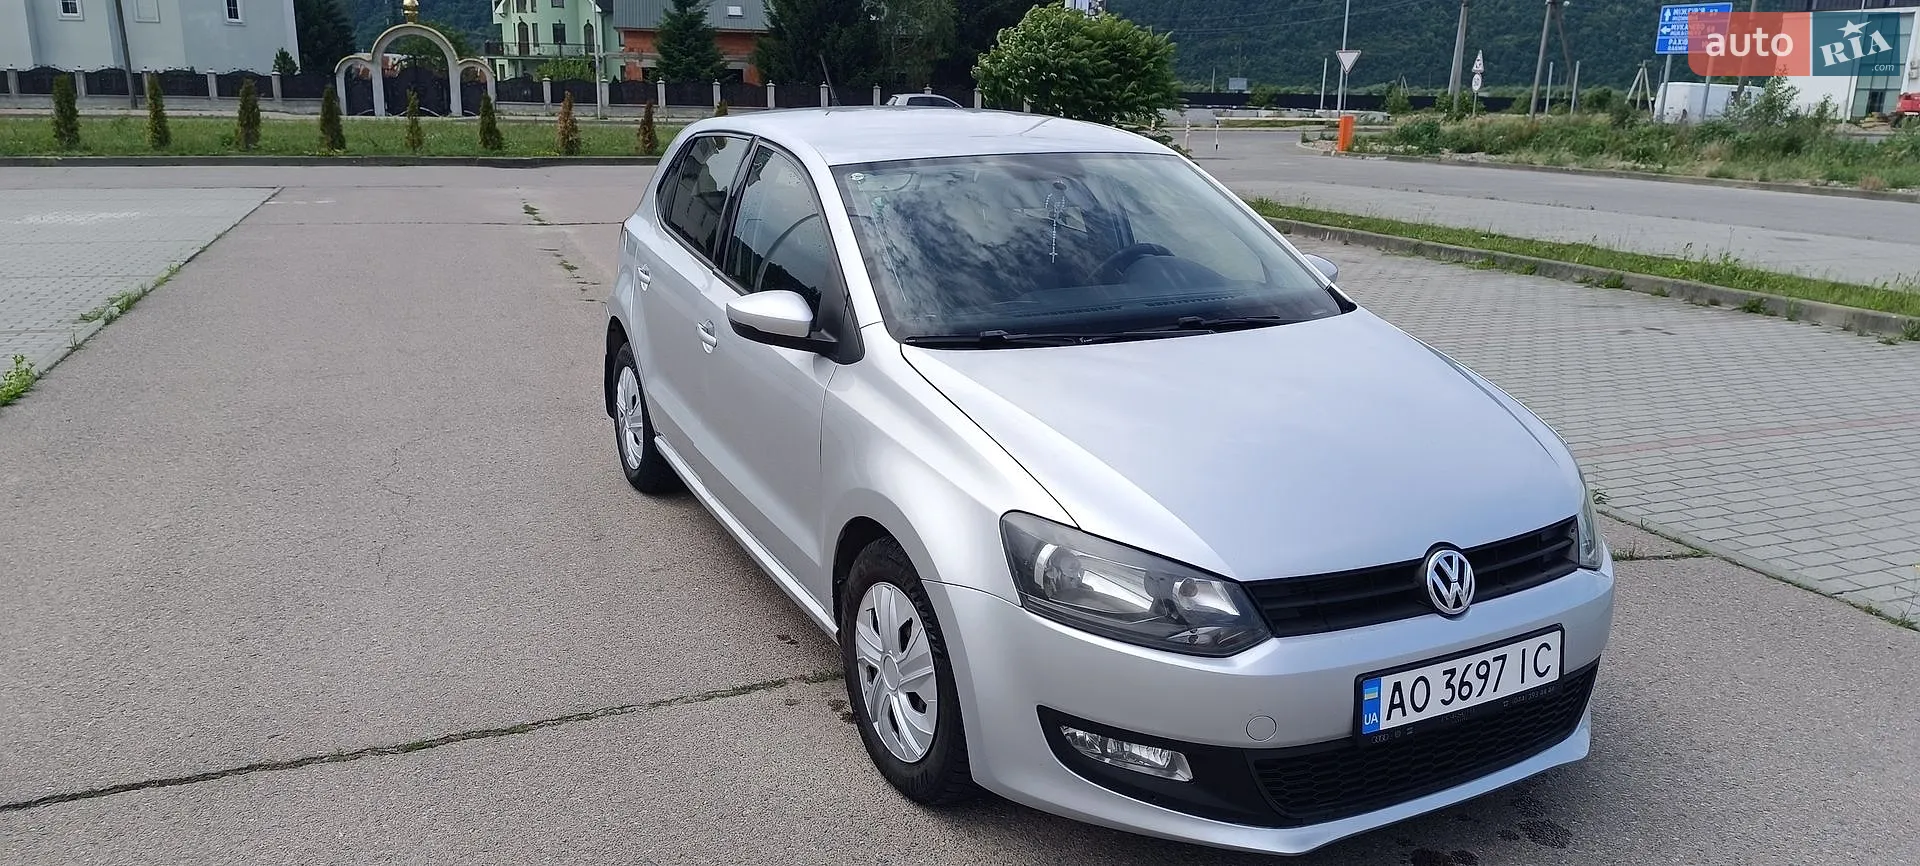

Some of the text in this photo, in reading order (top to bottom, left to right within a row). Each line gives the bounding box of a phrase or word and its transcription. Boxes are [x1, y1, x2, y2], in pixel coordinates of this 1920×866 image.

[1386, 675, 1431, 721] AO
[1440, 654, 1508, 706] 3697
[1364, 713, 1379, 726] UA
